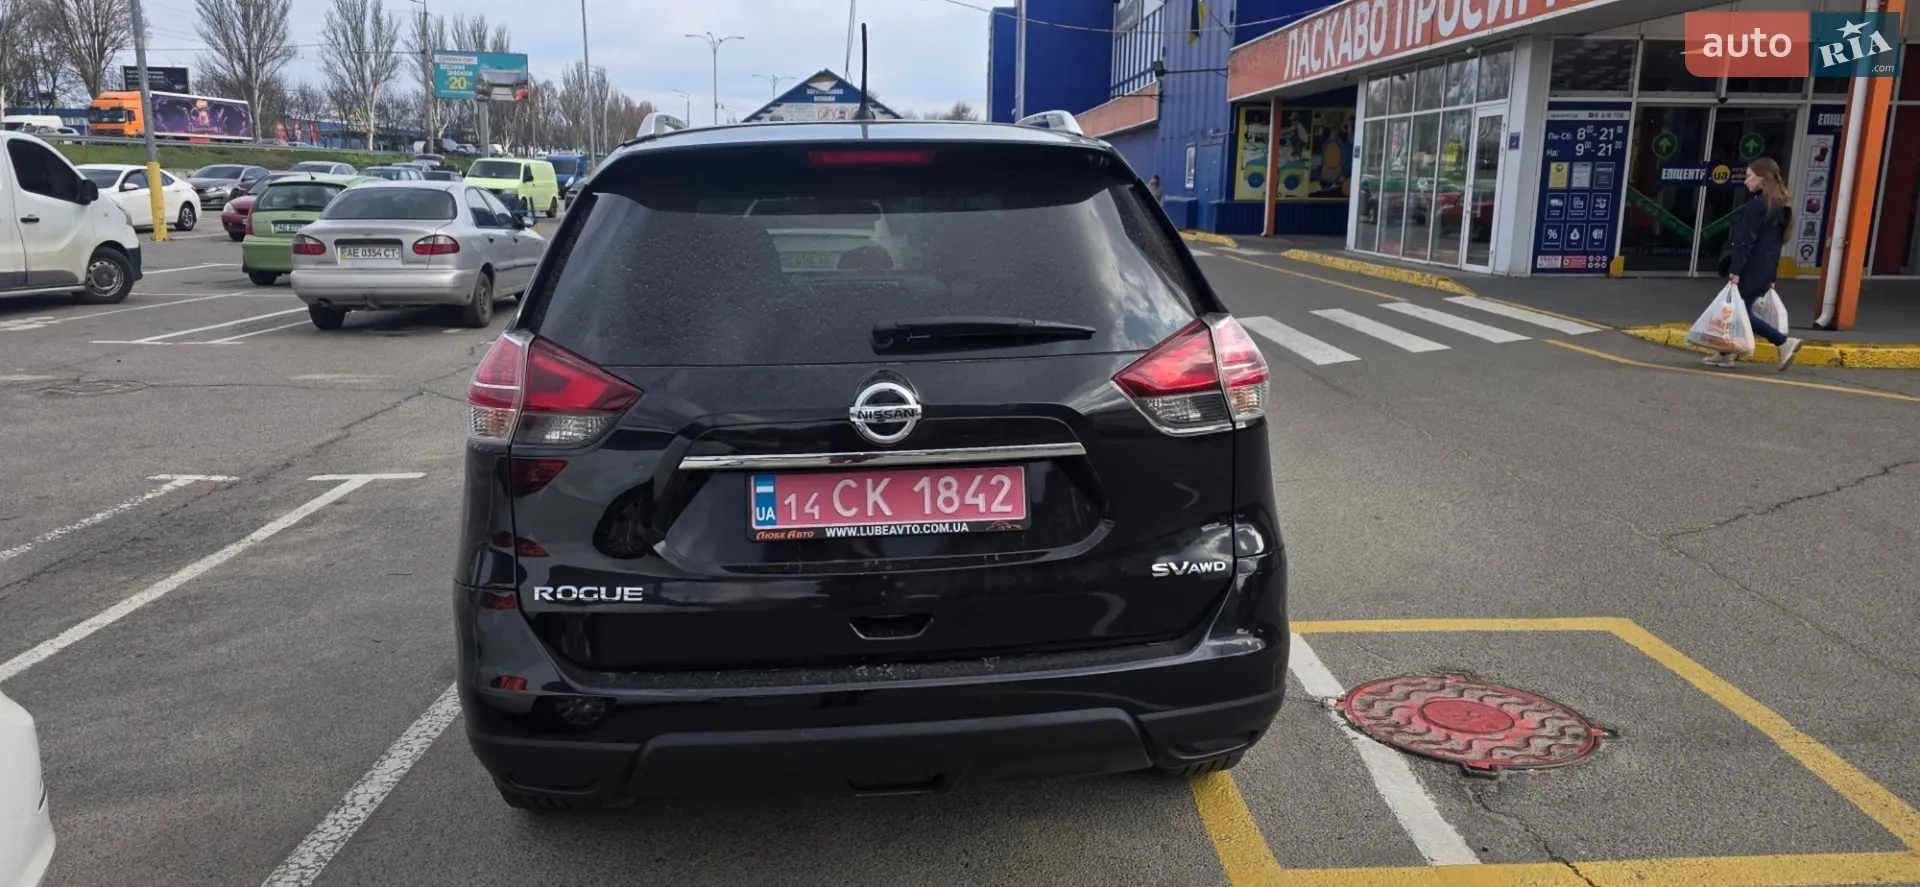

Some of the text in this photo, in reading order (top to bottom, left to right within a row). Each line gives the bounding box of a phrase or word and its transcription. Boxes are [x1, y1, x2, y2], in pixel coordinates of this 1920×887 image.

[1283, 0, 1386, 79] ЛАСКАВО
[347, 248, 397, 258] AE 0354 CT
[857, 408, 915, 420] NISSAN
[783, 474, 1013, 521] 14 CK 1842
[756, 507, 776, 521] UA
[825, 521, 969, 538] WWW.LUBEAVTO.COM.UA
[533, 585, 643, 601] ROGUE
